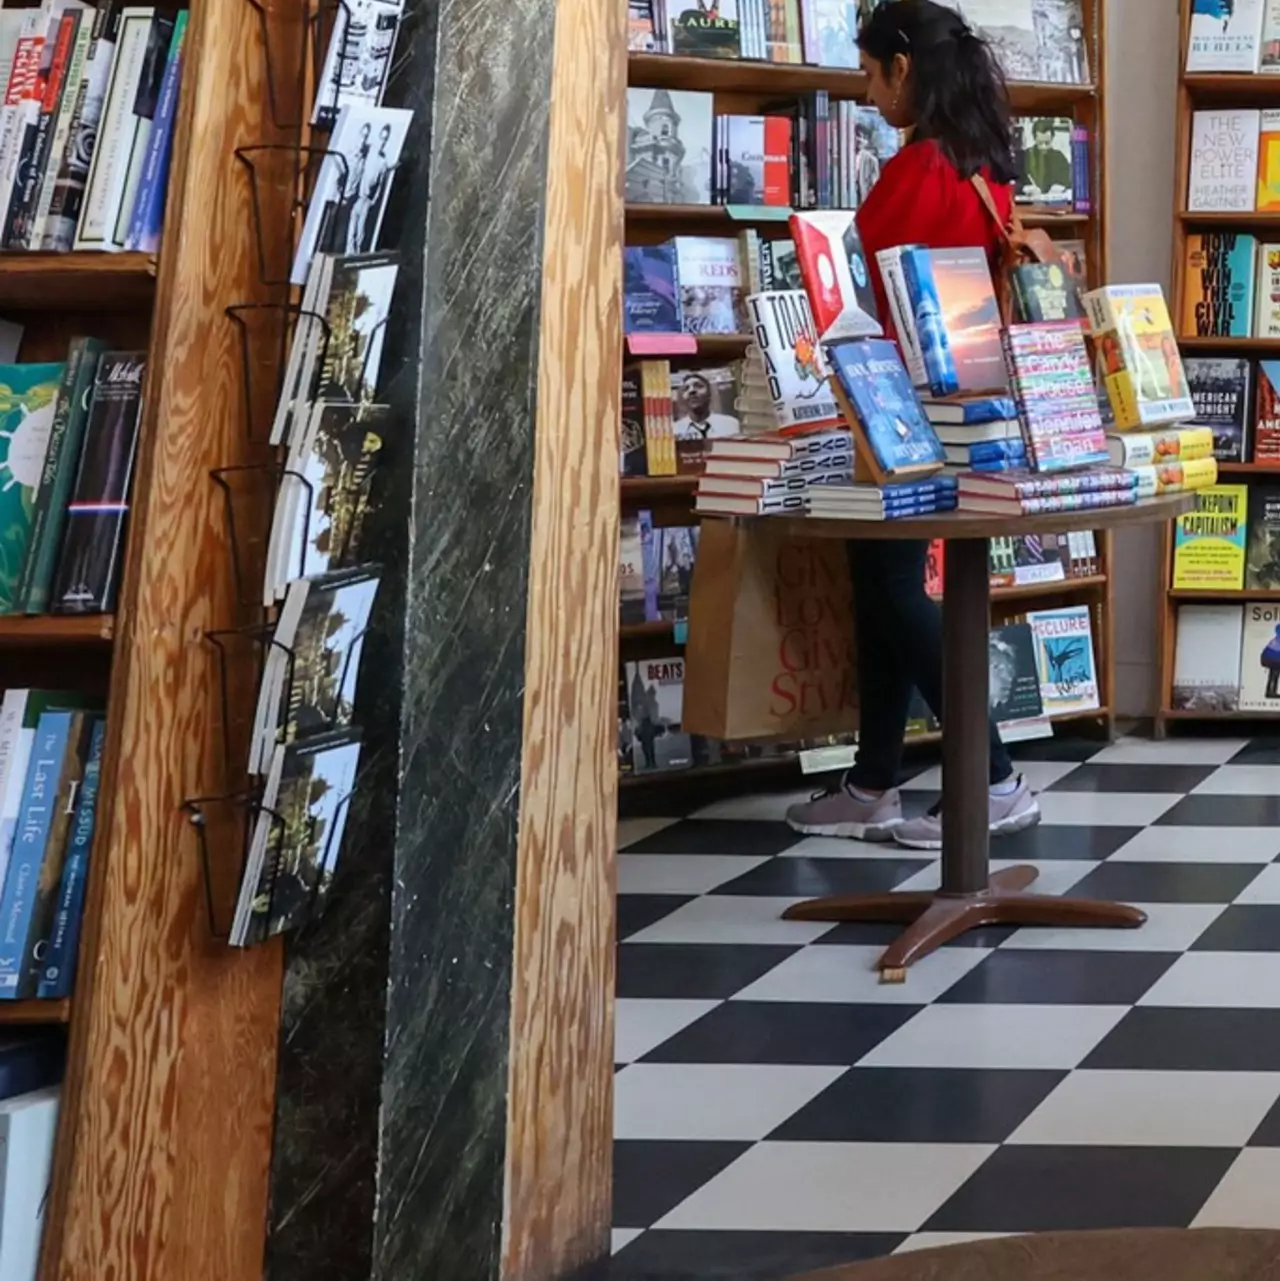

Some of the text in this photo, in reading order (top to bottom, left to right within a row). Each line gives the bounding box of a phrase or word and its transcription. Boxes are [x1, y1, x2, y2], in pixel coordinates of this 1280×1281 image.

[1209, 116, 1241, 131] THE
[1203, 134, 1246, 146] NEW
[1195, 149, 1254, 163] POWER
[1201, 164, 1245, 179] ELITE
[1194, 185, 1248, 195] HEATHER
[1193, 198, 1248, 209] GAUTNEY
[700, 265, 738, 277] REDS
[1195, 302, 1235, 320] CIVIL
[1196, 320, 1231, 336] WAR
[1035, 331, 1065, 349] The
[750, 298, 781, 401] TOAD
[1027, 355, 1079, 374] Candy
[1183, 518, 1238, 536] CAPITALISM
[647, 662, 684, 680] BEATS
